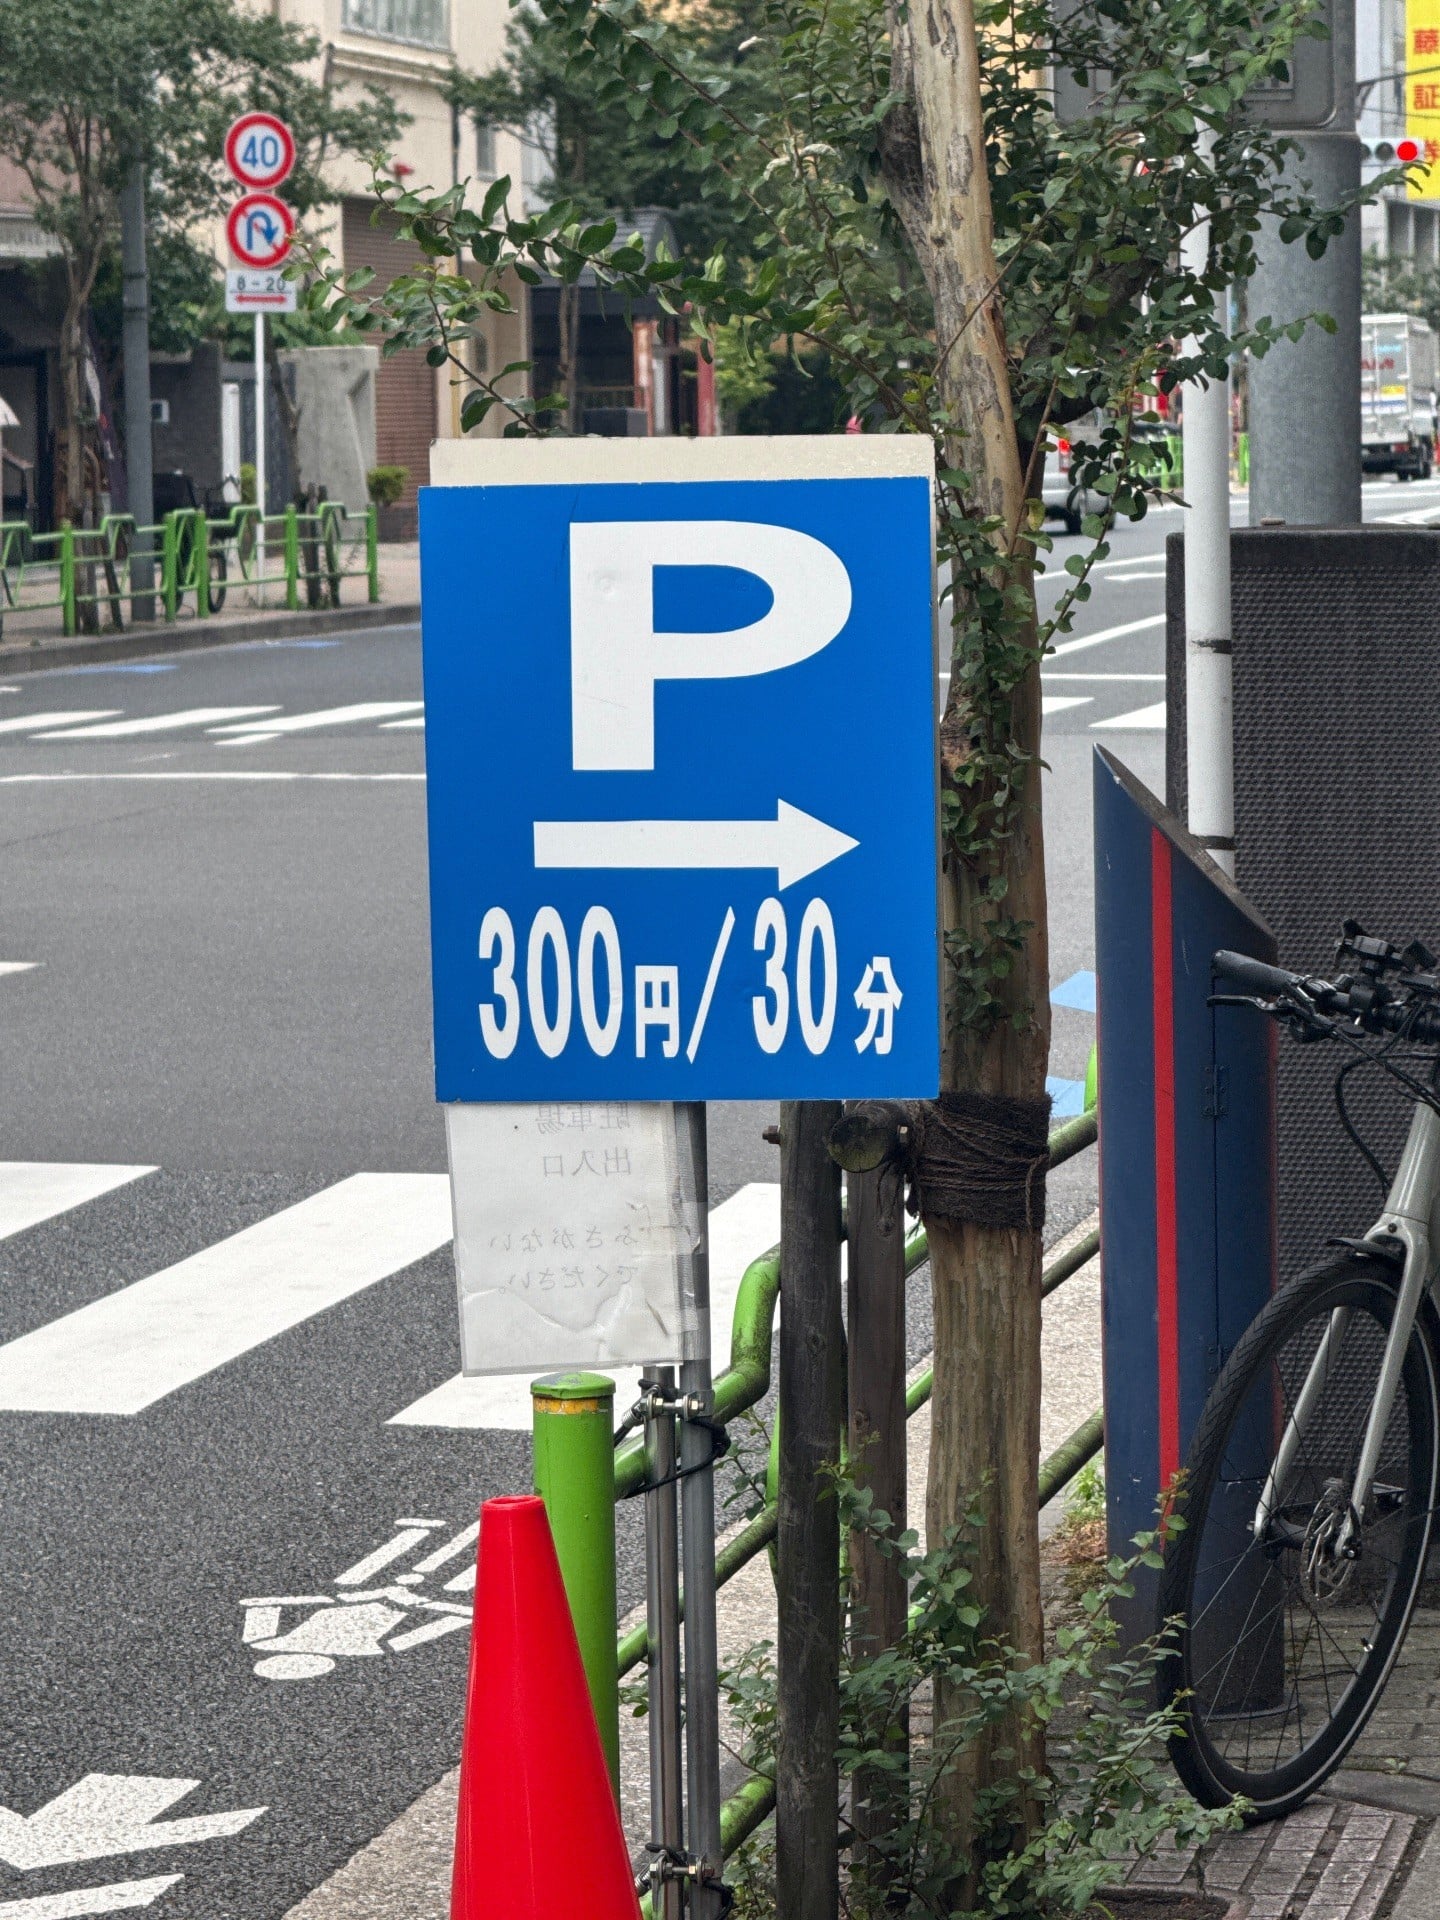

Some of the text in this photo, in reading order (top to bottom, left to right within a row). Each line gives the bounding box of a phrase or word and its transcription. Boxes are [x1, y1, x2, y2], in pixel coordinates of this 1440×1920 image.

[241, 135, 279, 168] 40
[569, 520, 852, 771] P
[478, 897, 904, 1065] 300円/30分
